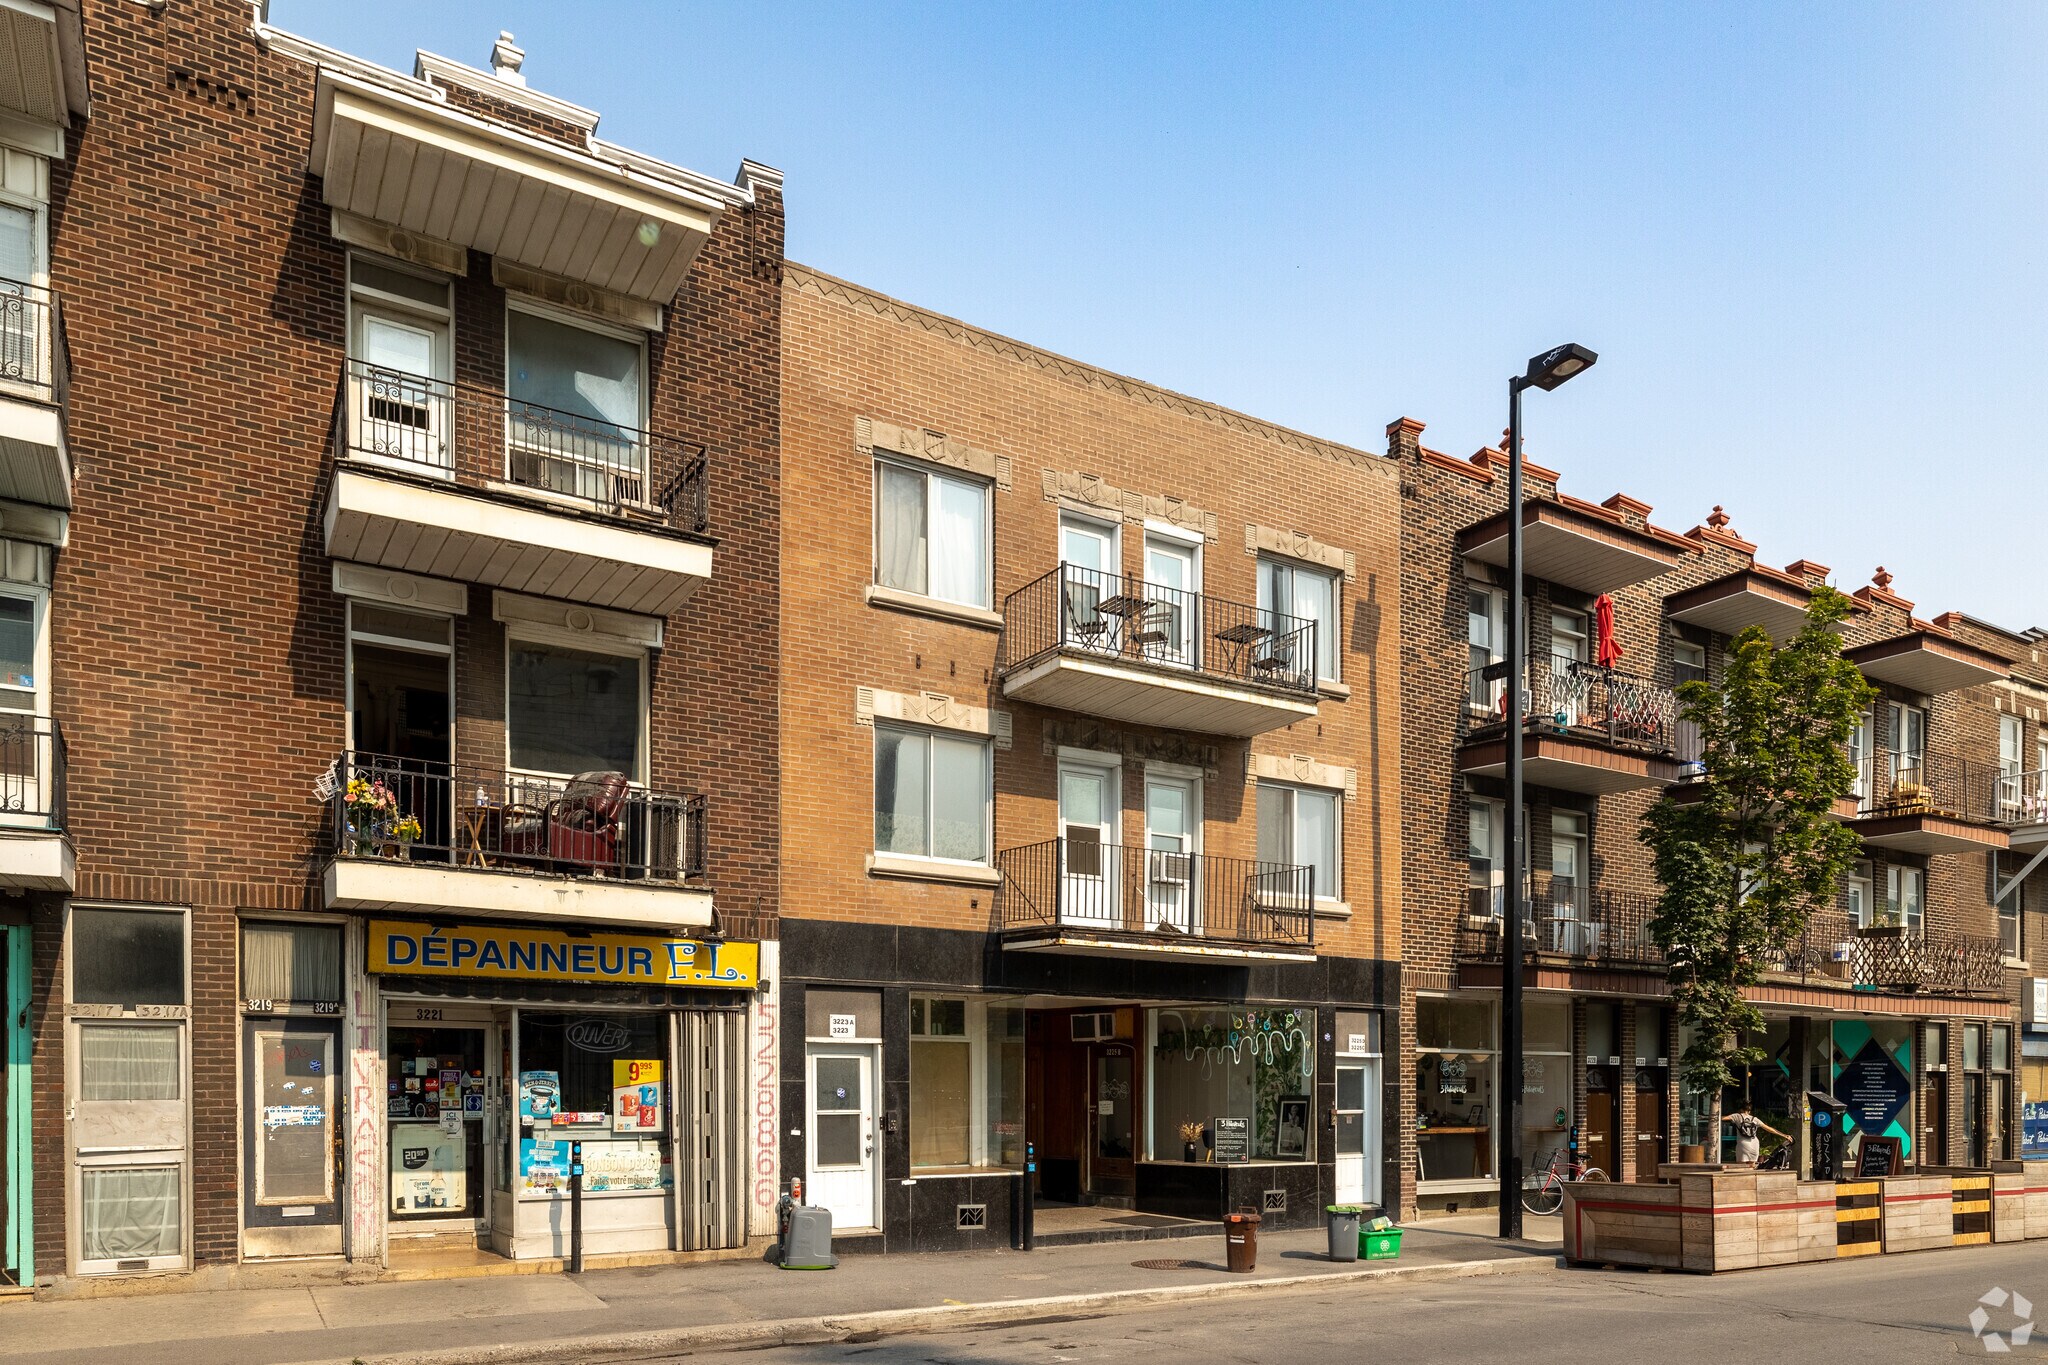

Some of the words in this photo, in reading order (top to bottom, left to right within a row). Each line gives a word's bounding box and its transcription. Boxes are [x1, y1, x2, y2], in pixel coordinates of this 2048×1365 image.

[386, 927, 653, 977] DÉPANNEUR
[662, 942, 748, 982] F.L.
[70, 1005, 114, 1017] 3217
[248, 999, 272, 1011] 3219
[315, 1002, 339, 1013] 3219A
[142, 1006, 188, 1018] 3217A
[416, 1008, 443, 1021] 3221
[571, 1024, 632, 1046] OUVERT
[756, 1003, 776, 1208] 5228866
[590, 1176, 609, 1186] Faites
